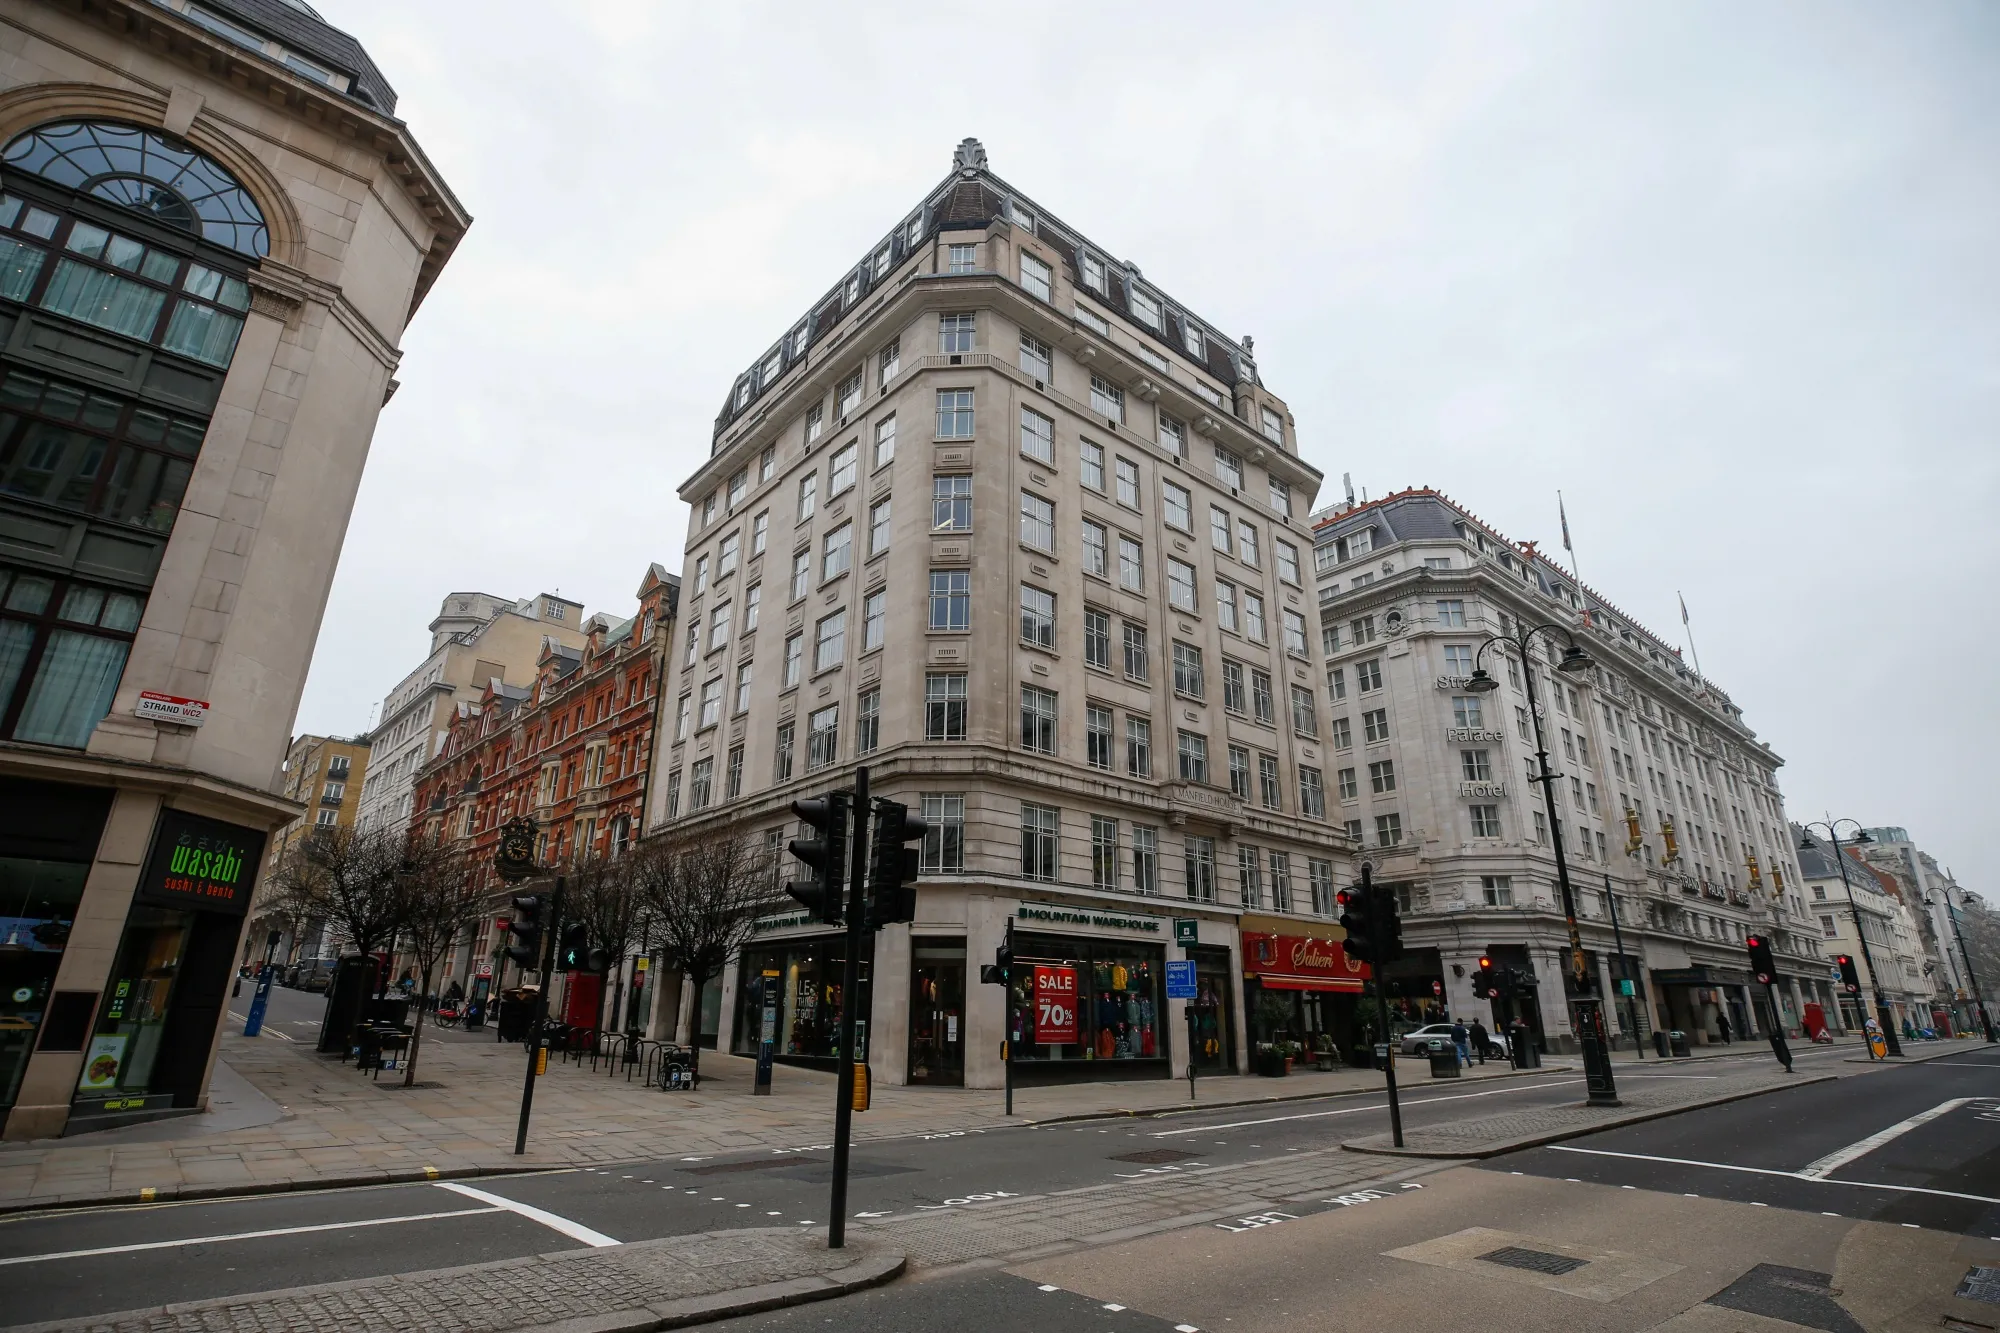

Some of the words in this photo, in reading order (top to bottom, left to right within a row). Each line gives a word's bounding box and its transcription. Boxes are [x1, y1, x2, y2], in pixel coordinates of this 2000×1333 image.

[1438, 674, 1474, 689] Stra
[143, 701, 180, 714] STRAND
[182, 707, 202, 718] WC2
[1446, 727, 1504, 742] Palace
[1178, 788, 1213, 805] MANFIELD
[1214, 796, 1237, 810] HOUSE
[1460, 782, 1508, 798] Hotel
[170, 845, 245, 884] wasabi
[164, 877, 194, 892] sushi
[206, 881, 234, 899] bento
[1028, 908, 1091, 926] MOUNTAIN
[1092, 915, 1160, 932] WAREHOUSE
[1291, 941, 1334, 971] Salieri
[1039, 975, 1073, 990] SALE
[917, 1131, 986, 1140] LOOK
[914, 1191, 1020, 1210] LOOK
[1321, 1189, 1397, 1206] LOOK
[1215, 1211, 1300, 1232] LEFT
